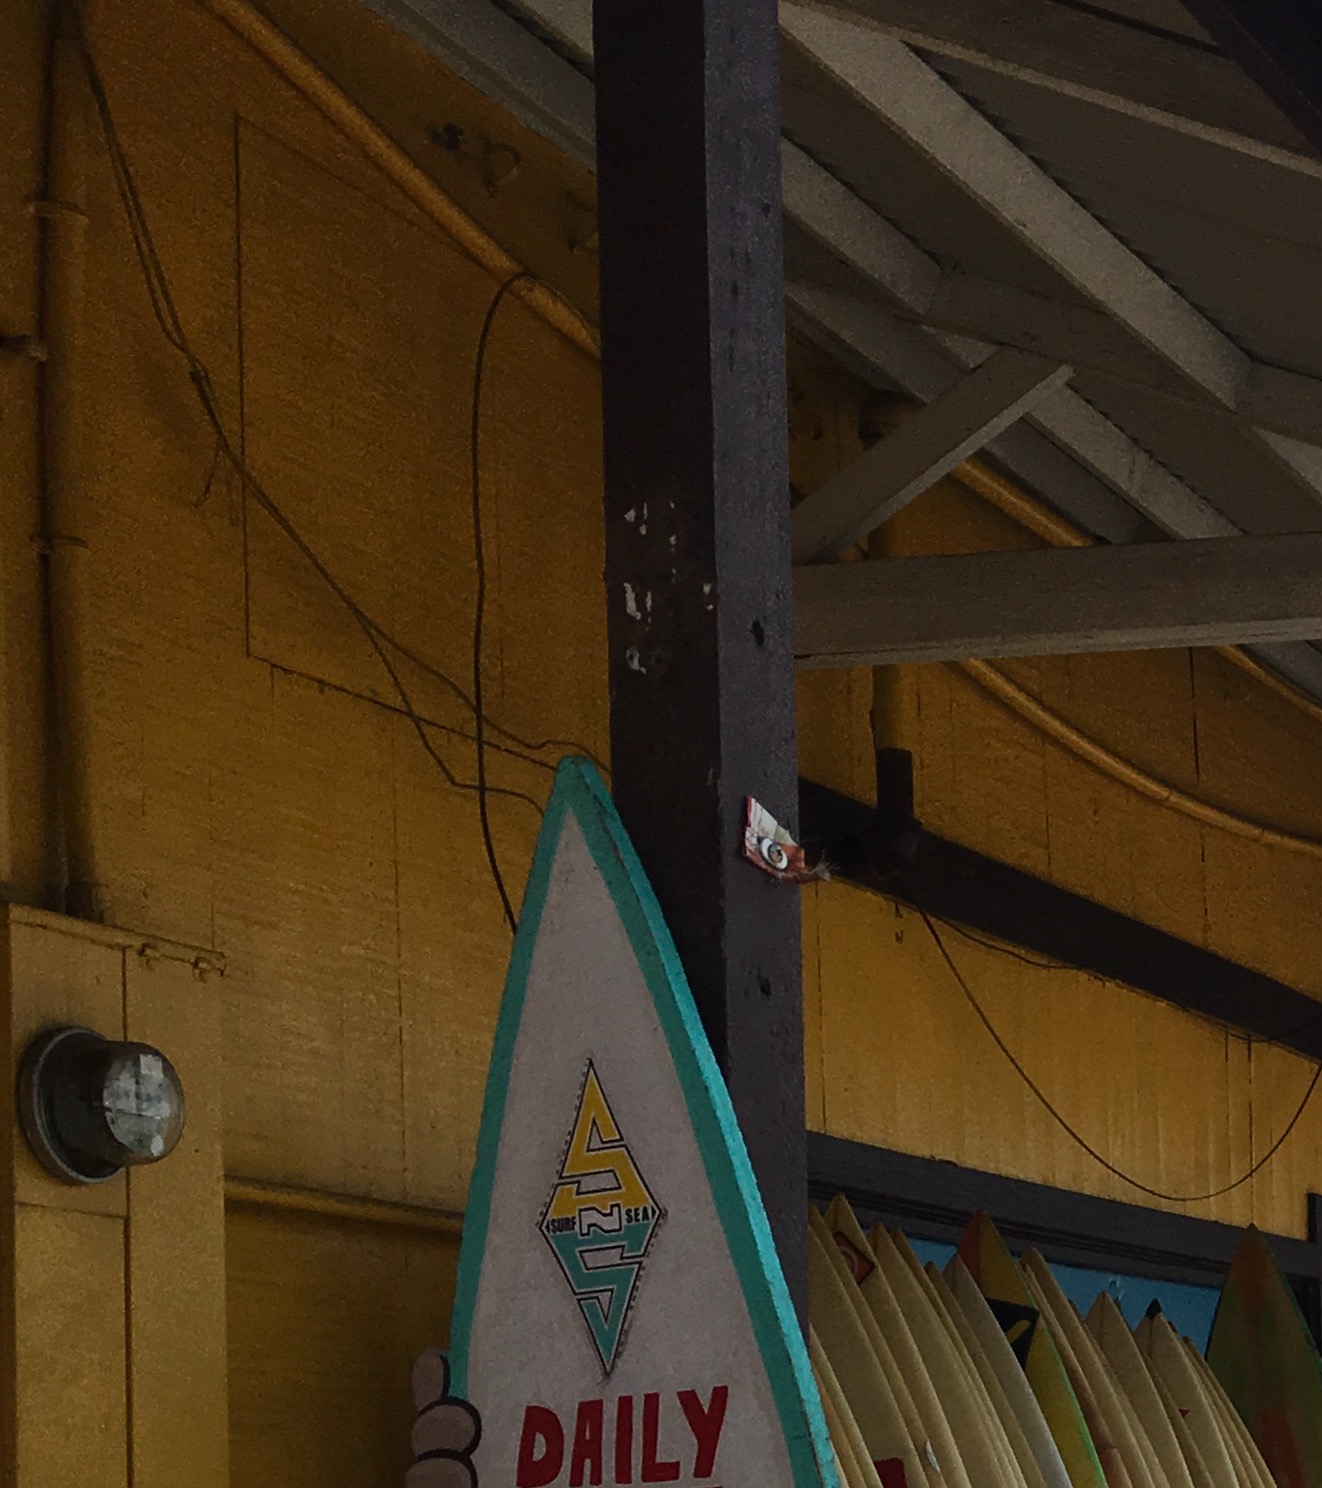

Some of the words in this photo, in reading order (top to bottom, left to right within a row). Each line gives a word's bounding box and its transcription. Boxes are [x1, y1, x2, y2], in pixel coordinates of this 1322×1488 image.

[551, 1215, 577, 1234] SURF
[624, 1204, 650, 1224] SEA
[515, 1385, 729, 1488] DAILY
